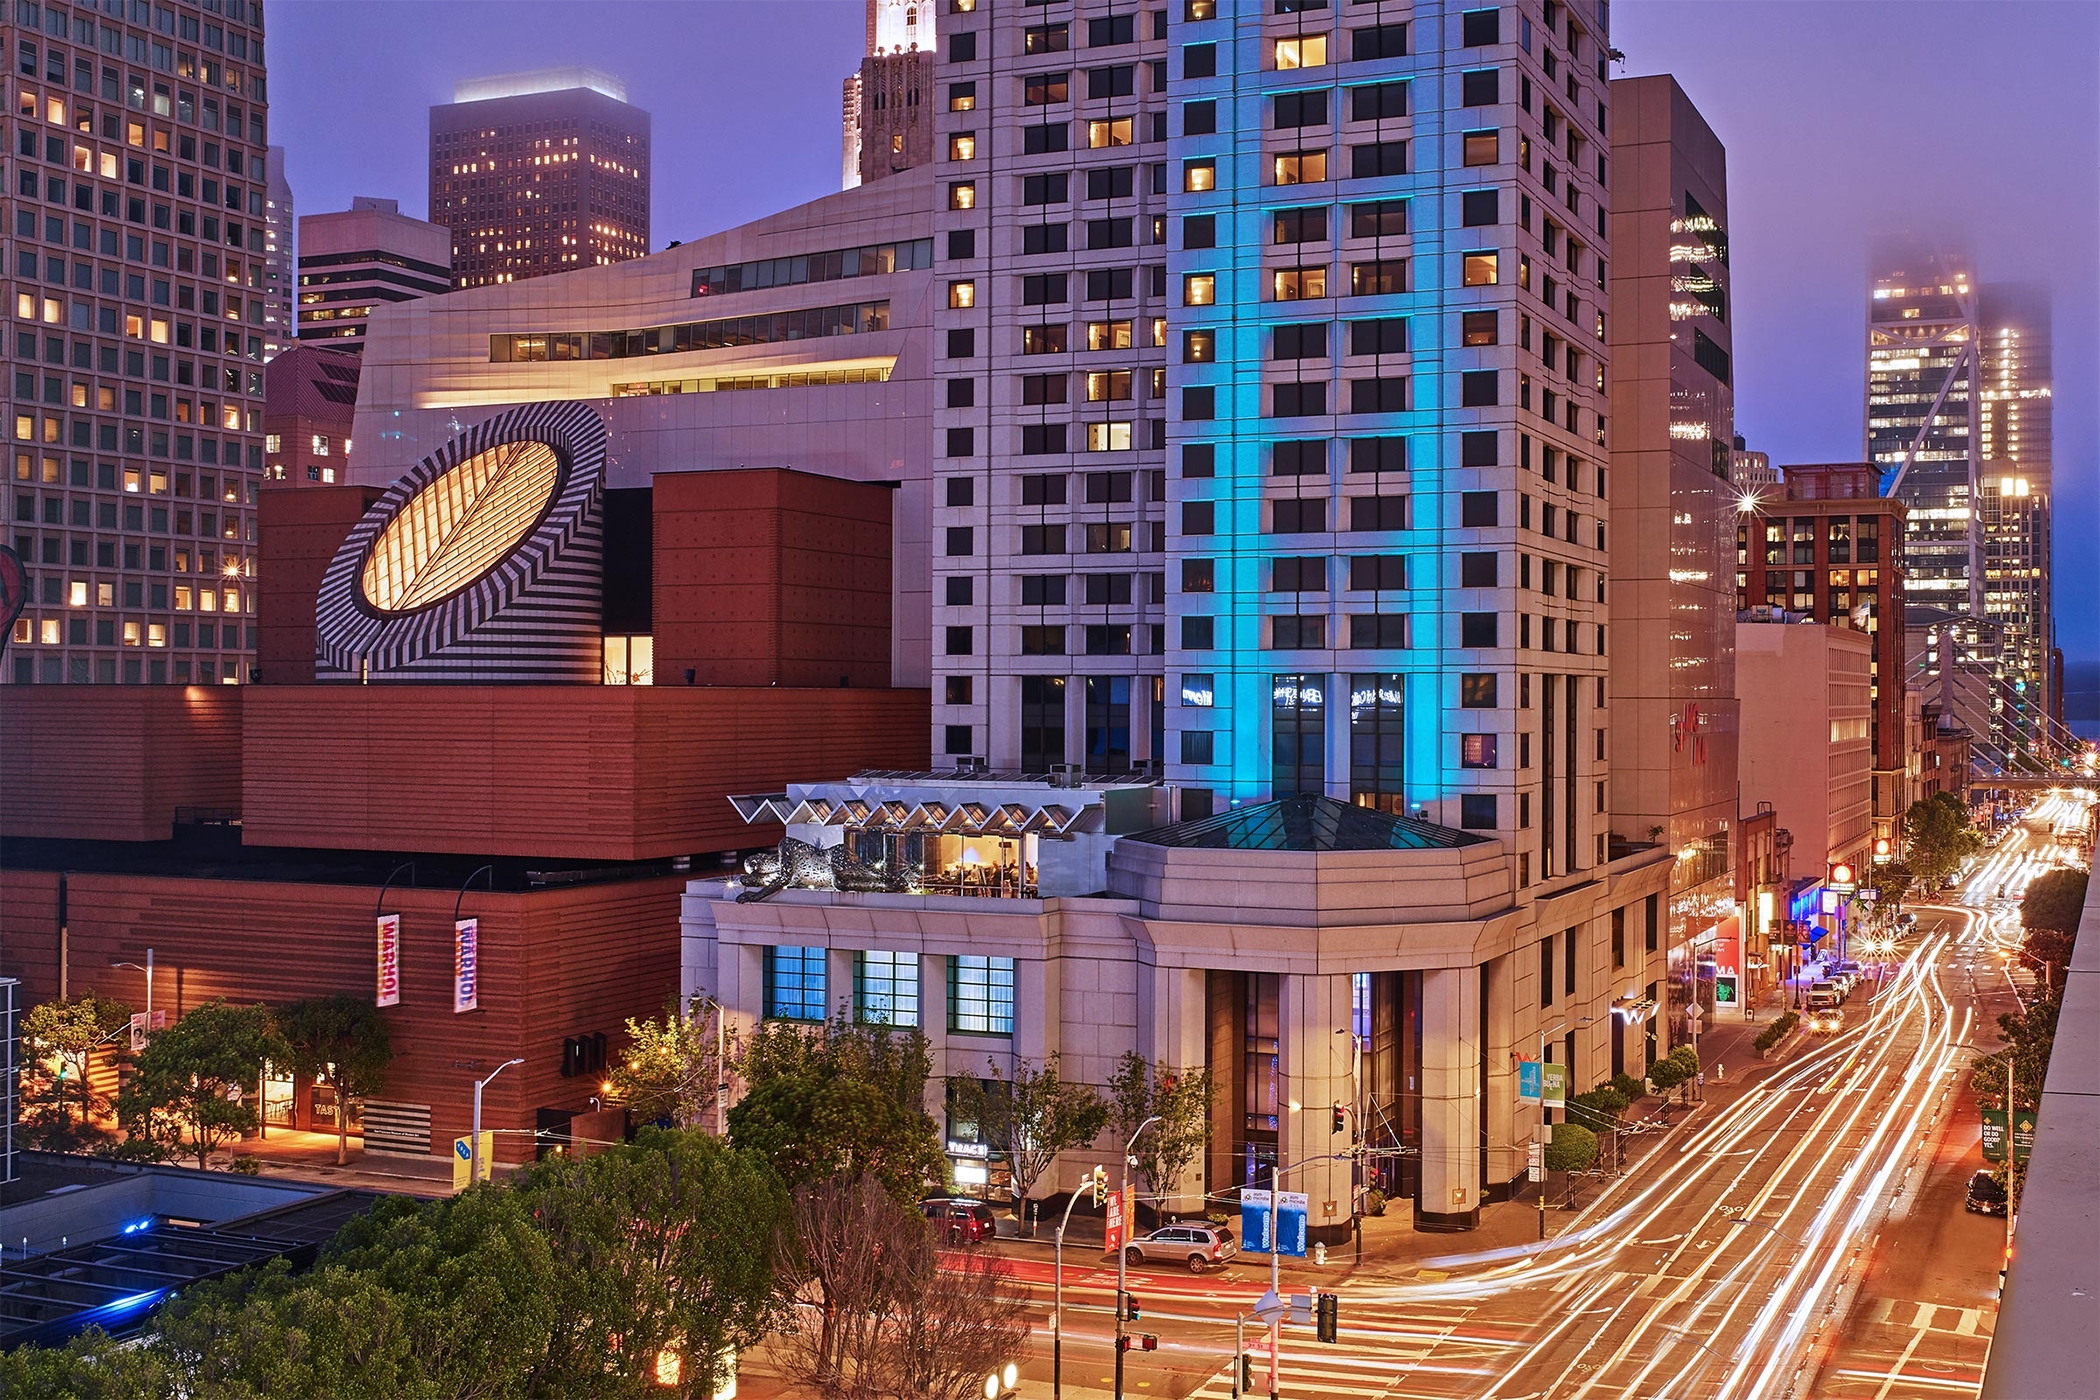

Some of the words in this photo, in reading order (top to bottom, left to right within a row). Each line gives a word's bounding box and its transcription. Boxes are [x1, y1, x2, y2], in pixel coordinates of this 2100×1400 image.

[383, 921, 397, 1000] WARHOL
[460, 926, 474, 1006] WARHOL
[1546, 1073, 1563, 1081] YERBA
[315, 1103, 341, 1116] TAST
[1108, 1205, 1120, 1217] ARE
[1262, 1211, 1270, 1249] Welcome
[1296, 1214, 1306, 1252] Welcome
